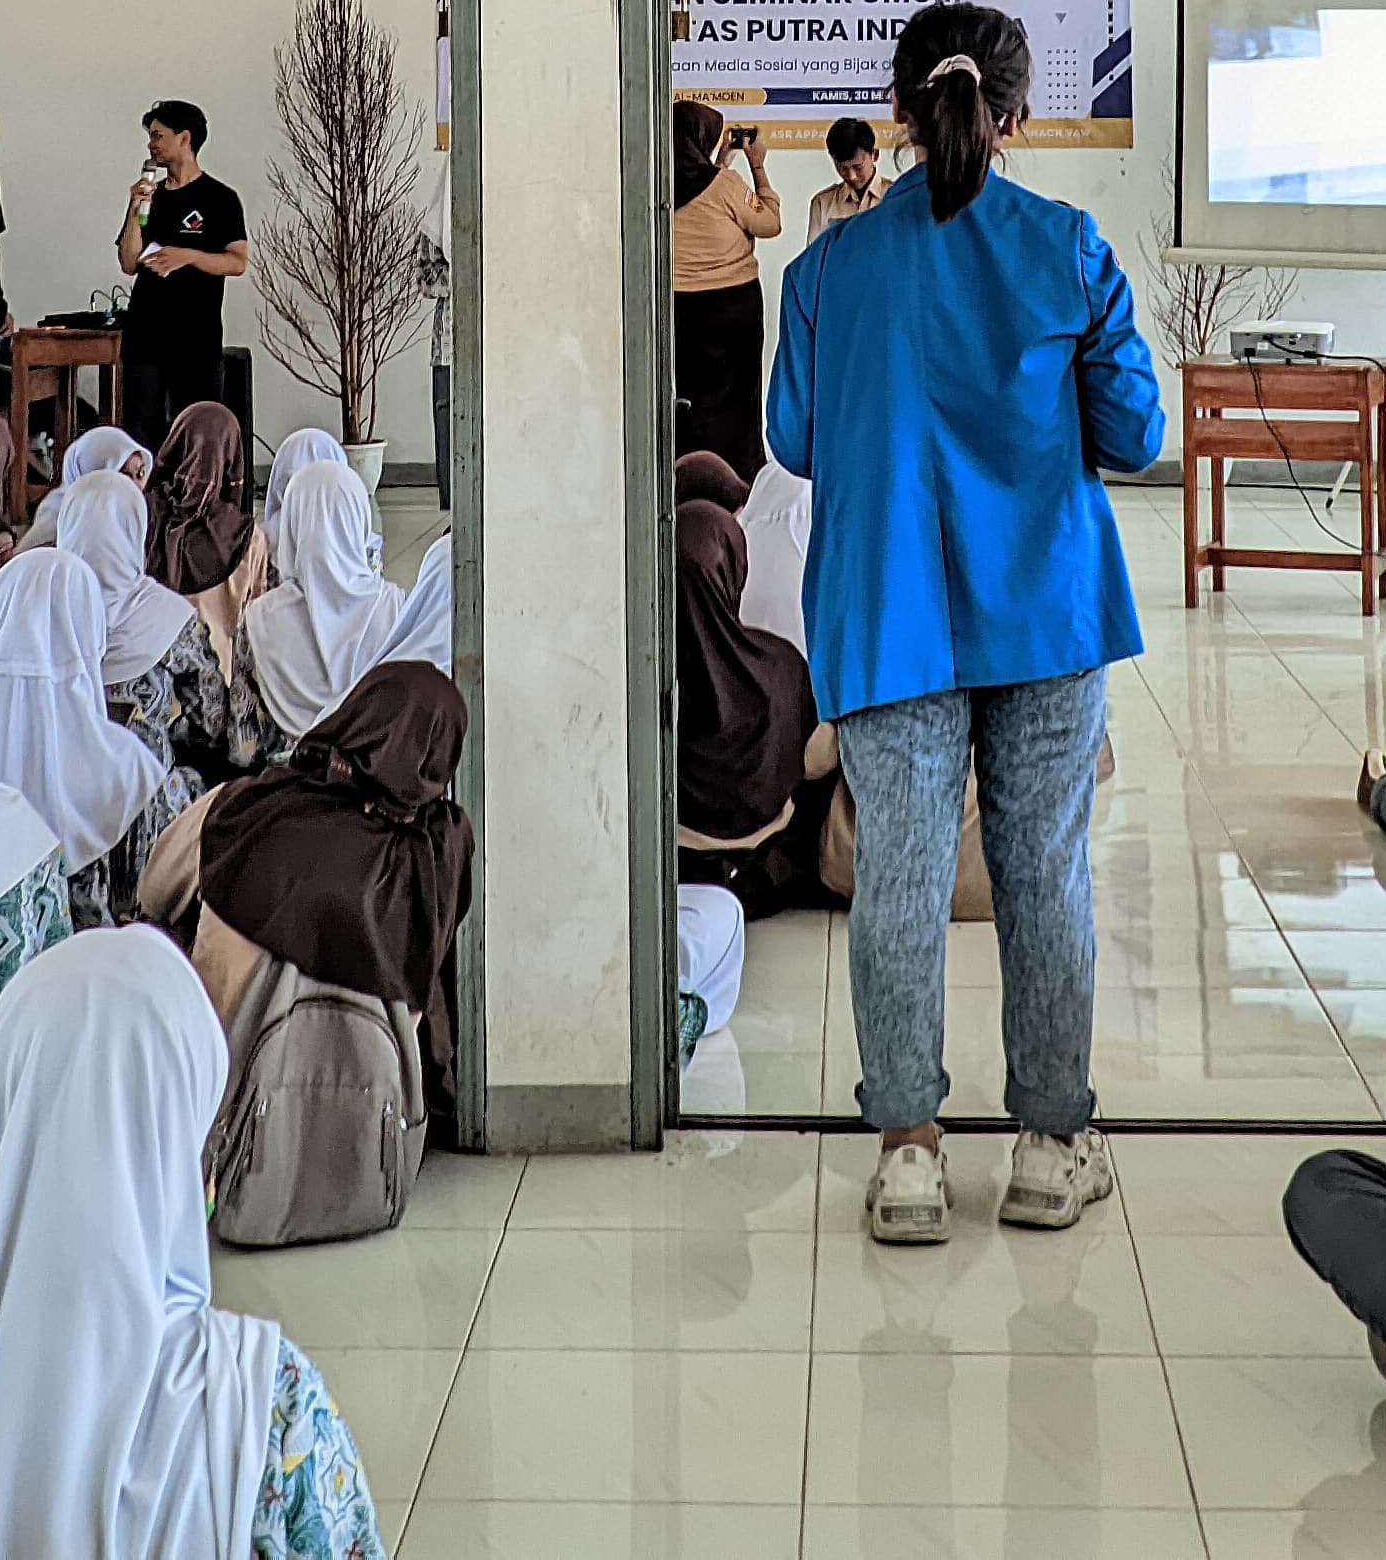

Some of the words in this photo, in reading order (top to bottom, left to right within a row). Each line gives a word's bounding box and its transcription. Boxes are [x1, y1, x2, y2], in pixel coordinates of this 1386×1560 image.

[747, 17, 849, 42] PUTRA
[672, 61, 701, 71] aan
[705, 59, 750, 72] Media
[754, 58, 798, 72] Sosial
[801, 60, 840, 75] yang
[844, 58, 877, 74] Bijak
[855, 90, 869, 101] 30
